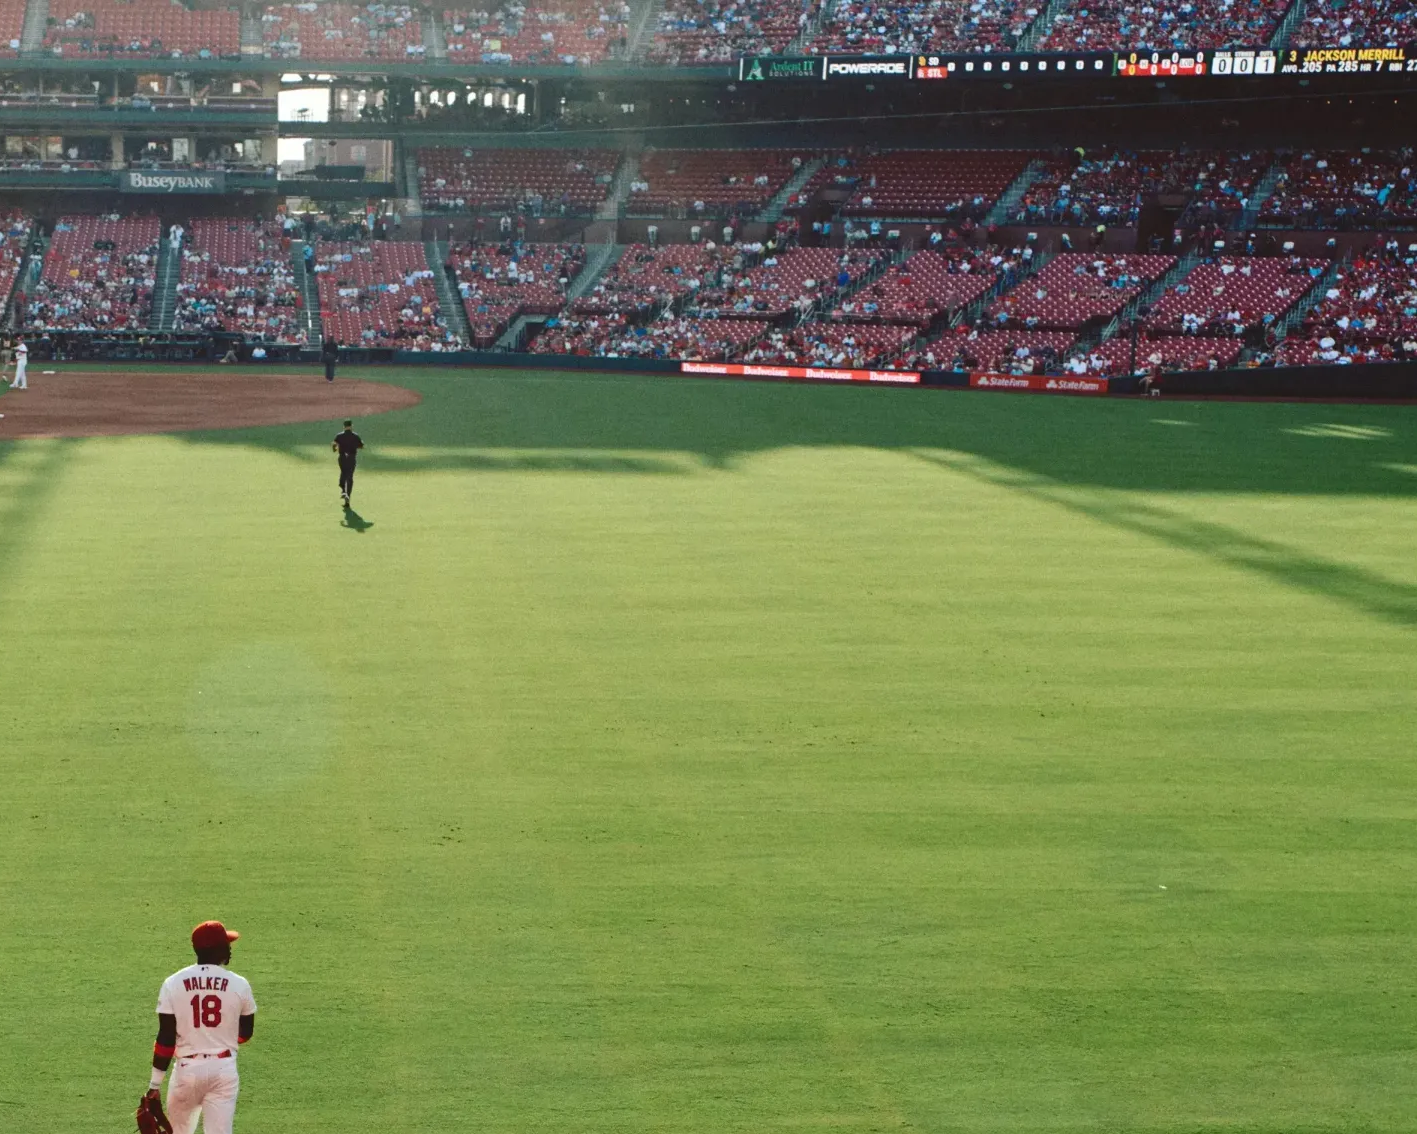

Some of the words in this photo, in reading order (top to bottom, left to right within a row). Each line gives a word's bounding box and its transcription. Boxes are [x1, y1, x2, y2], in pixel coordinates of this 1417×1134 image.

[1290, 51, 1297, 62] 3
[1304, 50, 1355, 61] JACKSON
[1358, 48, 1405, 60] MERRILL
[829, 63, 905, 74] POWERADE
[1219, 59, 1226, 72] 0
[1240, 58, 1248, 72] 0
[1326, 63, 1336, 72] PA
[1338, 61, 1358, 72] 285
[1360, 63, 1371, 72] HR
[1376, 61, 1382, 72] 7
[682, 363, 727, 374] Budweiser
[744, 366, 789, 377] Budweiser
[806, 369, 852, 379] Budweiser
[869, 371, 917, 382] Budweiser
[183, 976, 229, 992] WALKER
[190, 994, 222, 1028] 18
